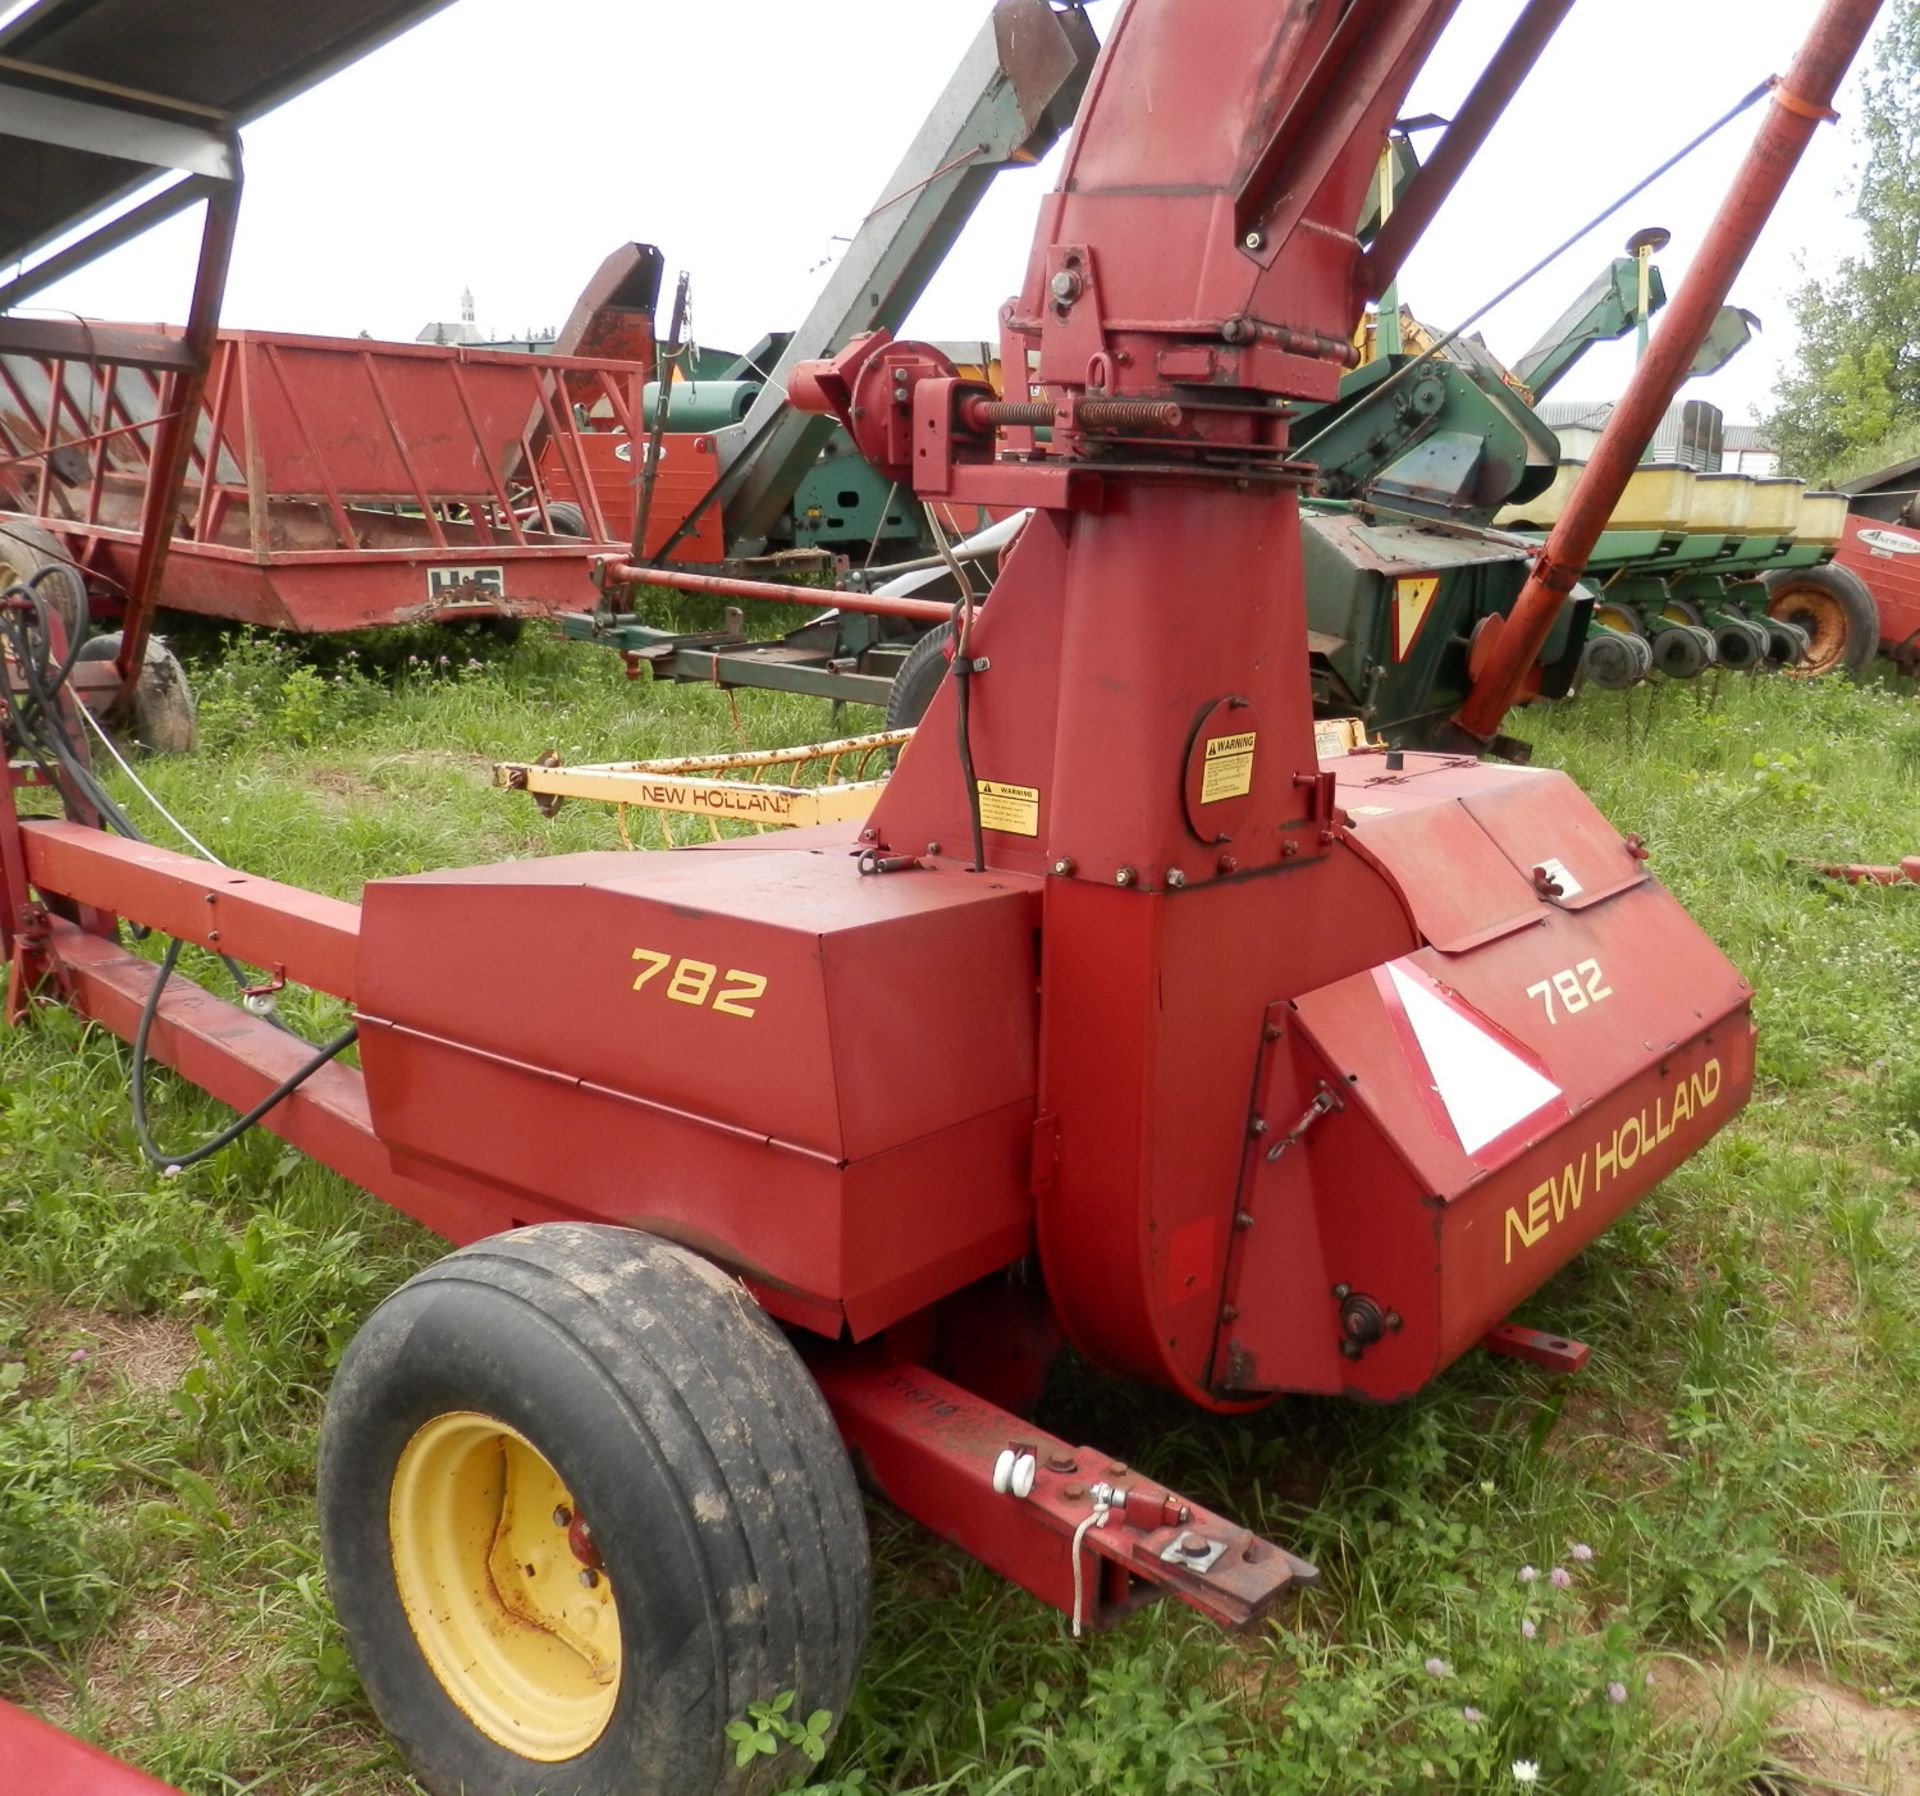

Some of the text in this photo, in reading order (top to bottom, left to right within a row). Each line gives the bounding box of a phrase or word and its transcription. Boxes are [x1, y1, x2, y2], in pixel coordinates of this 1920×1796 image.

[1217, 735, 1254, 752] WARNING
[642, 785, 686, 804] NEW
[1000, 786, 1033, 798] WARNING
[631, 947, 768, 1018] 782
[1525, 958, 1613, 1025] 782
[1505, 1058, 1721, 1265] NEW HOLLAND
